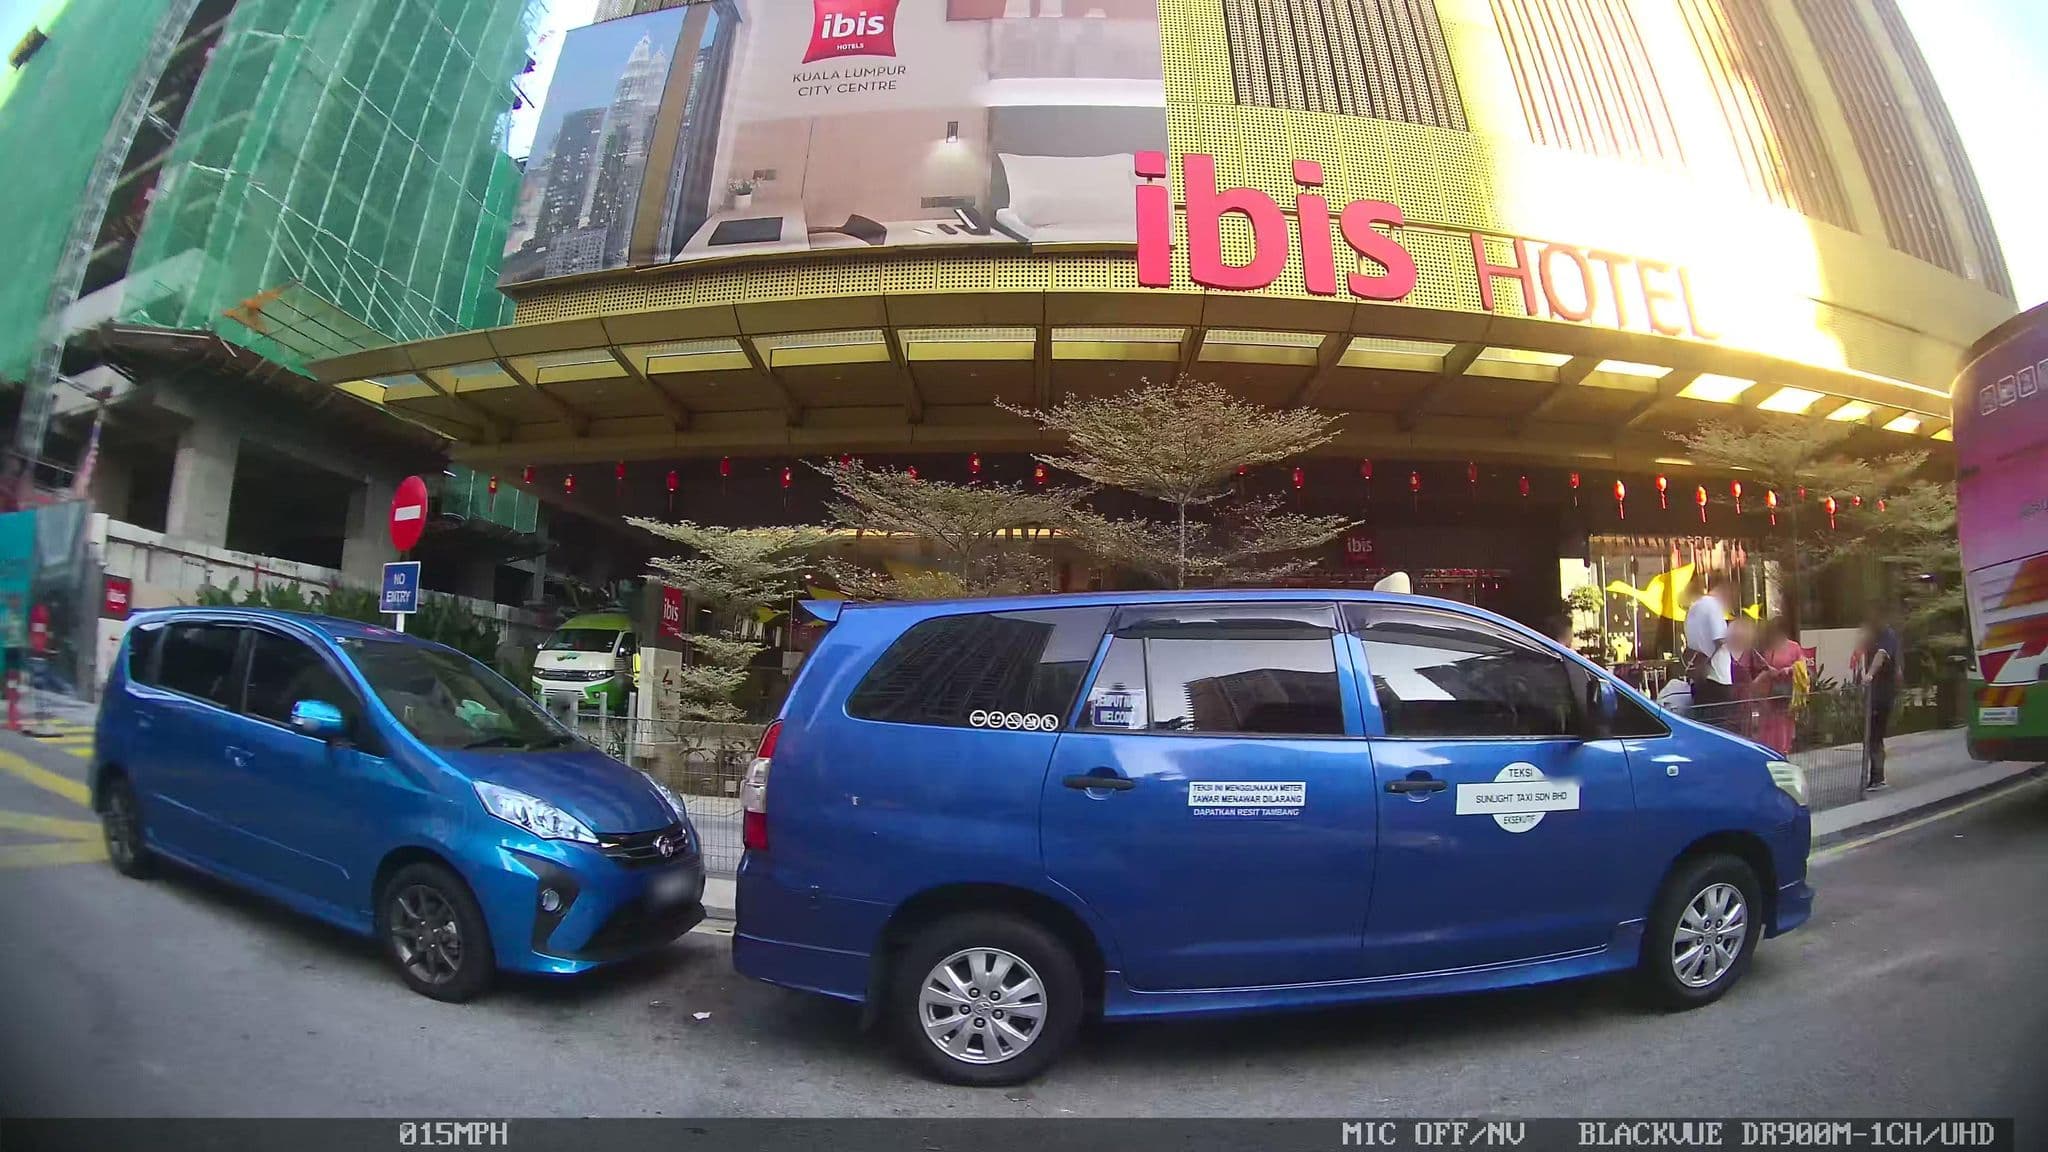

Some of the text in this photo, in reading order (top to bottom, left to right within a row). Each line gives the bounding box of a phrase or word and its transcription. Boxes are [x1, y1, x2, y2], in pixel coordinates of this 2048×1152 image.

[821, 11, 884, 39] ibis
[837, 43, 864, 51] HOTELS
[792, 65, 906, 83] KUALA LUMPUR
[798, 80, 897, 97] CITY CENTRE
[1134, 150, 1417, 301] ibis
[1347, 537, 1373, 553] ibis
[393, 572, 406, 585] NO
[386, 590, 412, 603] ENTRY
[663, 598, 679, 622] ibis
[1509, 768, 1533, 778] TEKSI
[1193, 784, 1303, 792] TEKSI INI MENGGUNAKAN METER
[1193, 795, 1302, 803] TAWAR MENAWAR DILARANG
[1476, 791, 1567, 804] SUNLIGHT TAXI SDN BHD
[1194, 808, 1300, 816] DAPATKAN RESIT TAMBANG
